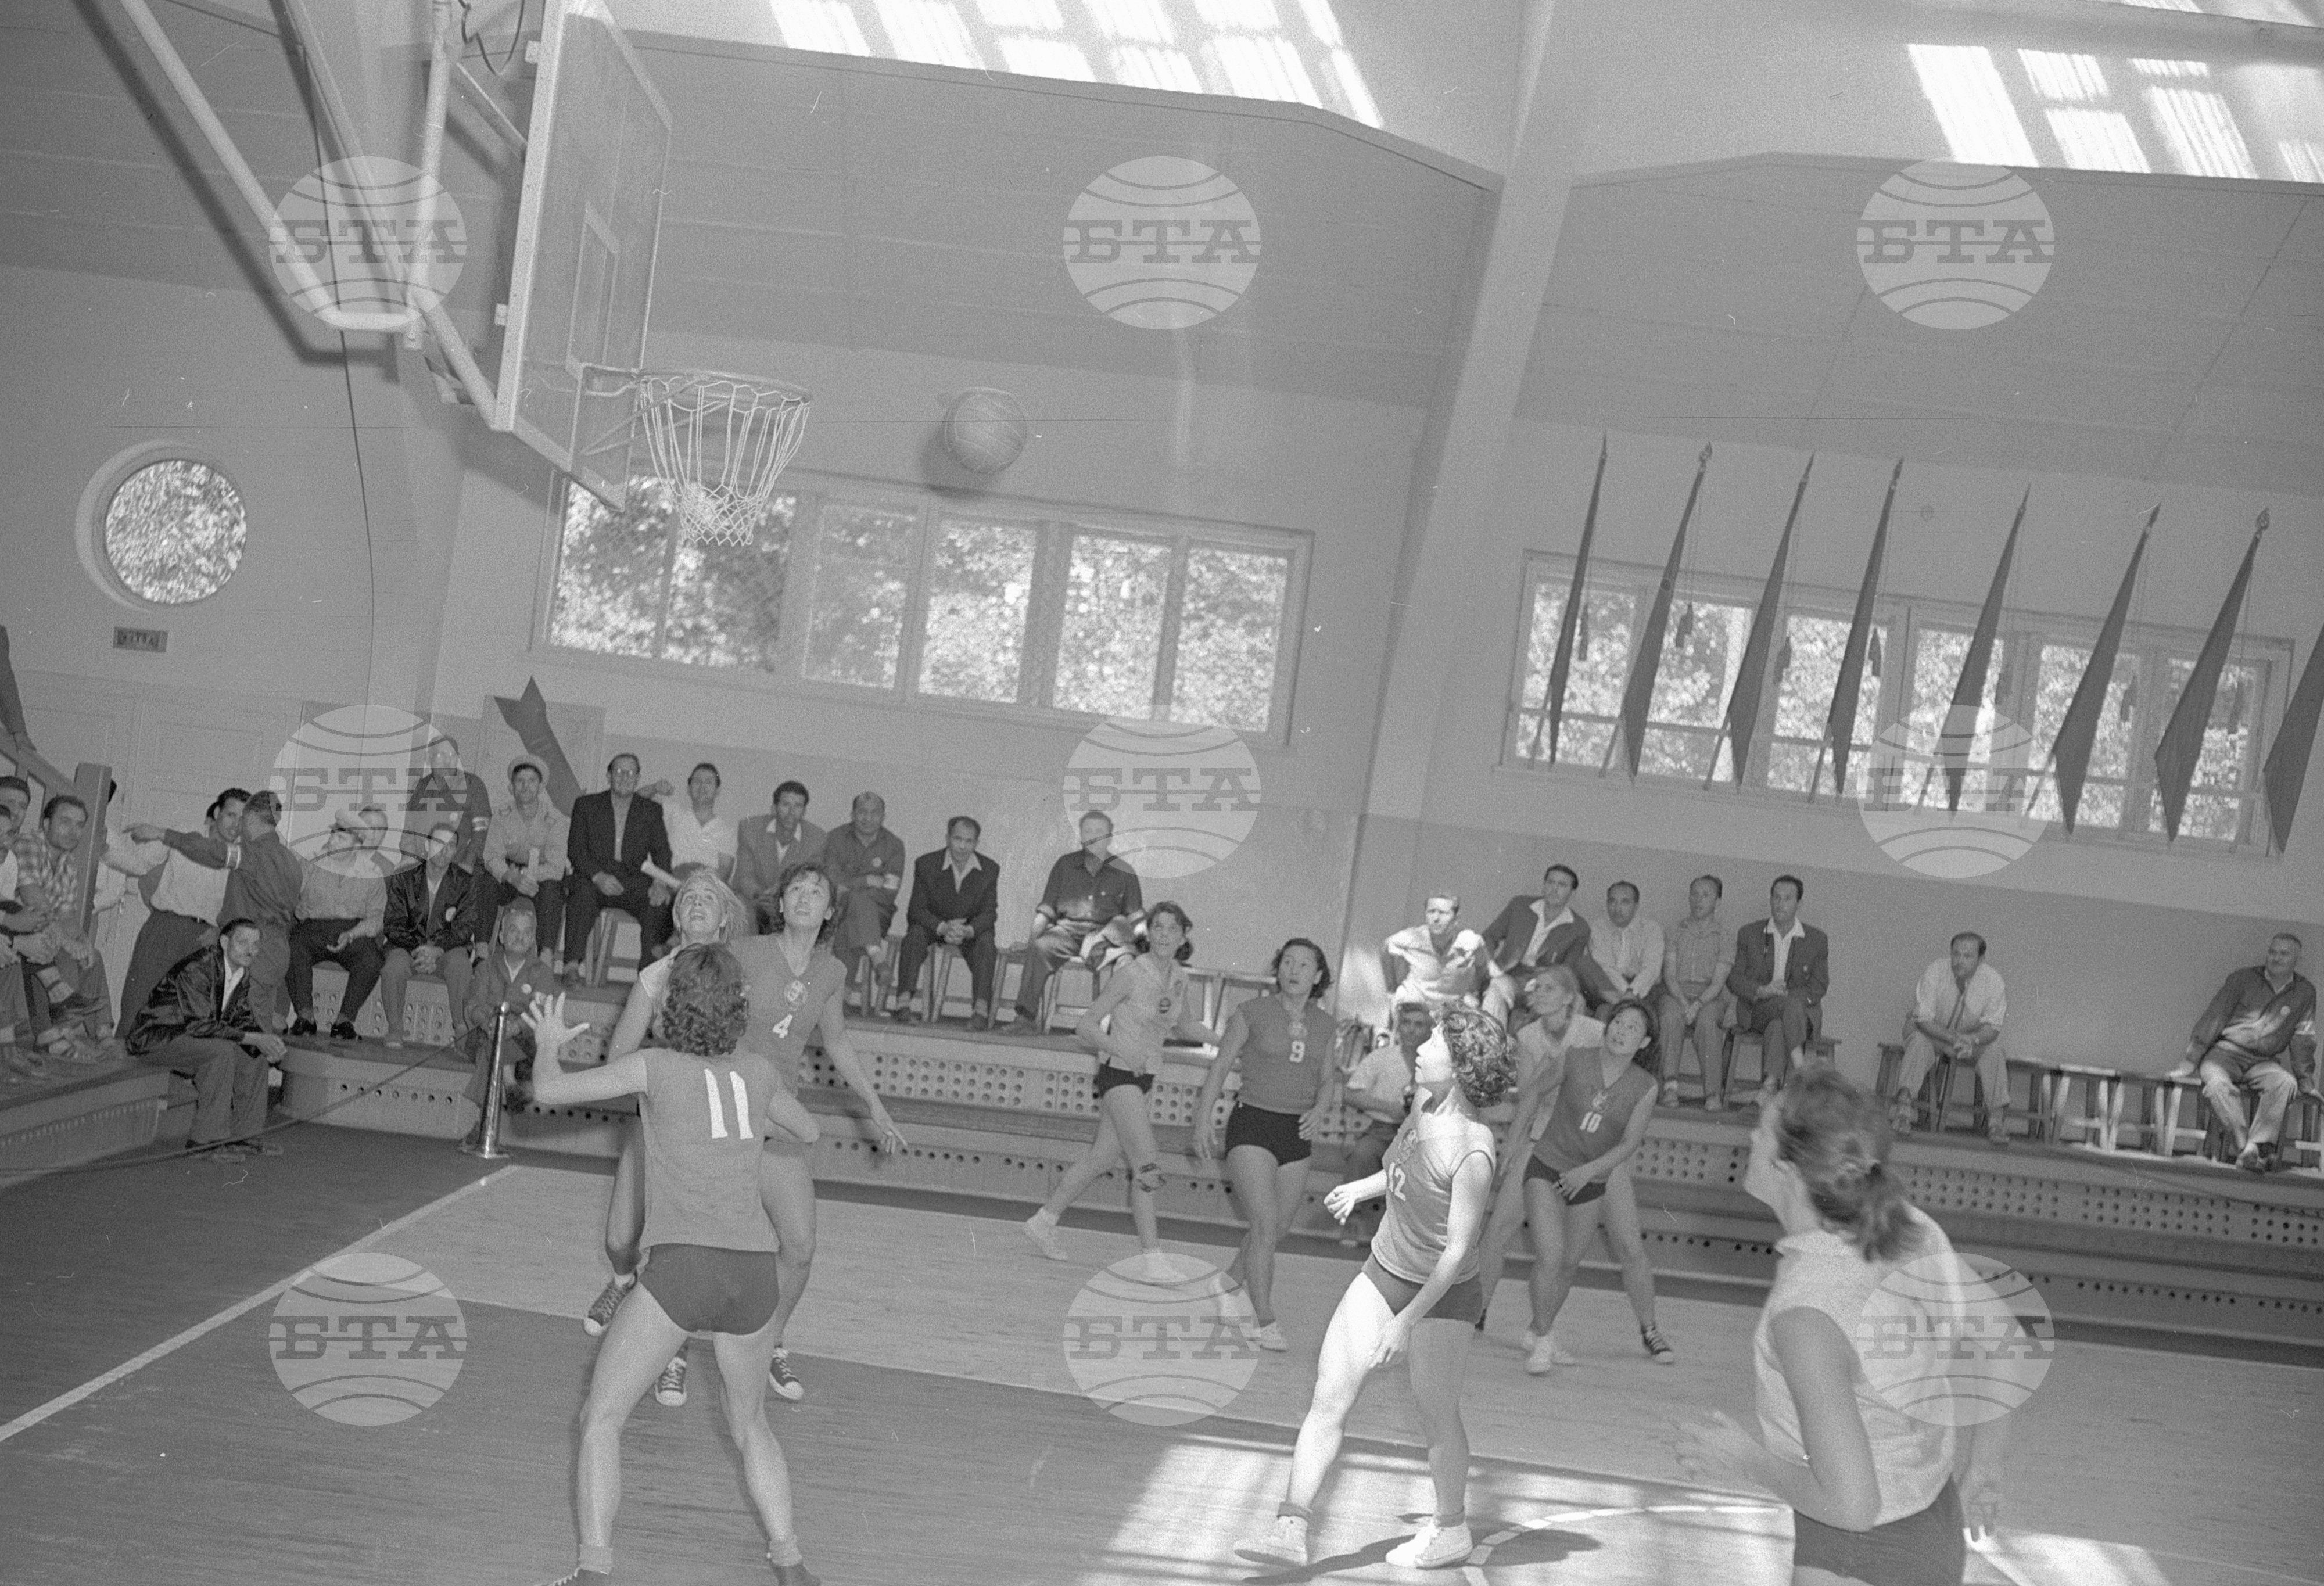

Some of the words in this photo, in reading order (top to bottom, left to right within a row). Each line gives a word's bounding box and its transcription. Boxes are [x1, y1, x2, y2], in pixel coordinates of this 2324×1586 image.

[773, 1014, 792, 1038] 4
[1289, 1040, 1305, 1063] 9
[704, 1068, 754, 1139] 11
[1579, 1111, 1604, 1133] 10
[1389, 1162, 1406, 1201] 12
